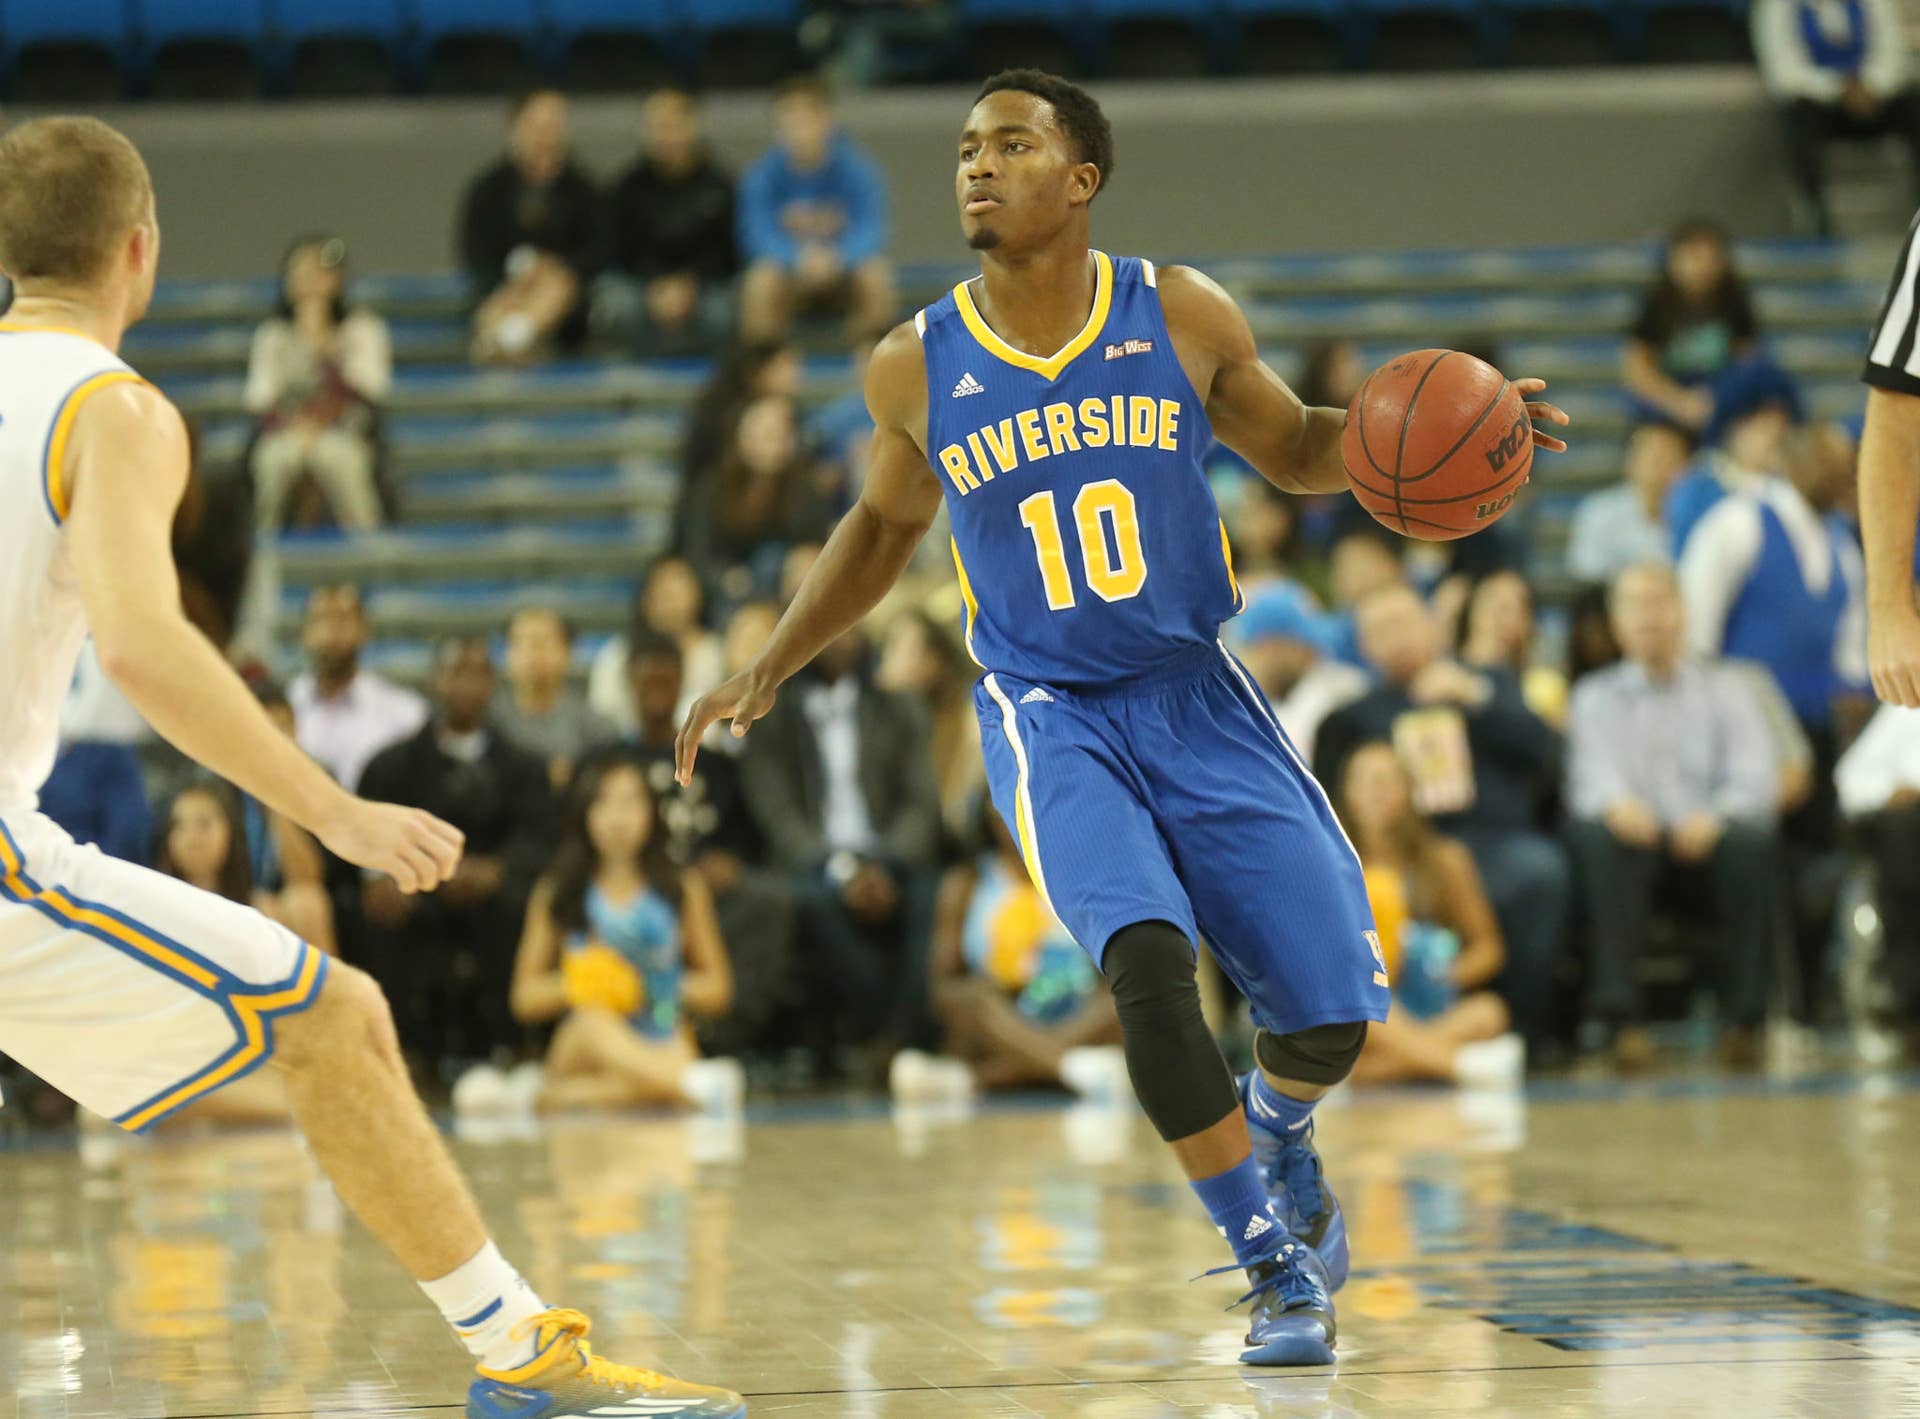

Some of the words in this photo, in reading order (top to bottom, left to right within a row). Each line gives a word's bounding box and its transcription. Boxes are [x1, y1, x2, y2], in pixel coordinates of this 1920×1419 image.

[952, 385, 985, 398] adidas
[939, 395, 1180, 496] RIVERSIDE
[1485, 411, 1530, 473] CAA
[1018, 478, 1147, 611] 10
[1244, 1221, 1272, 1240] adidas
